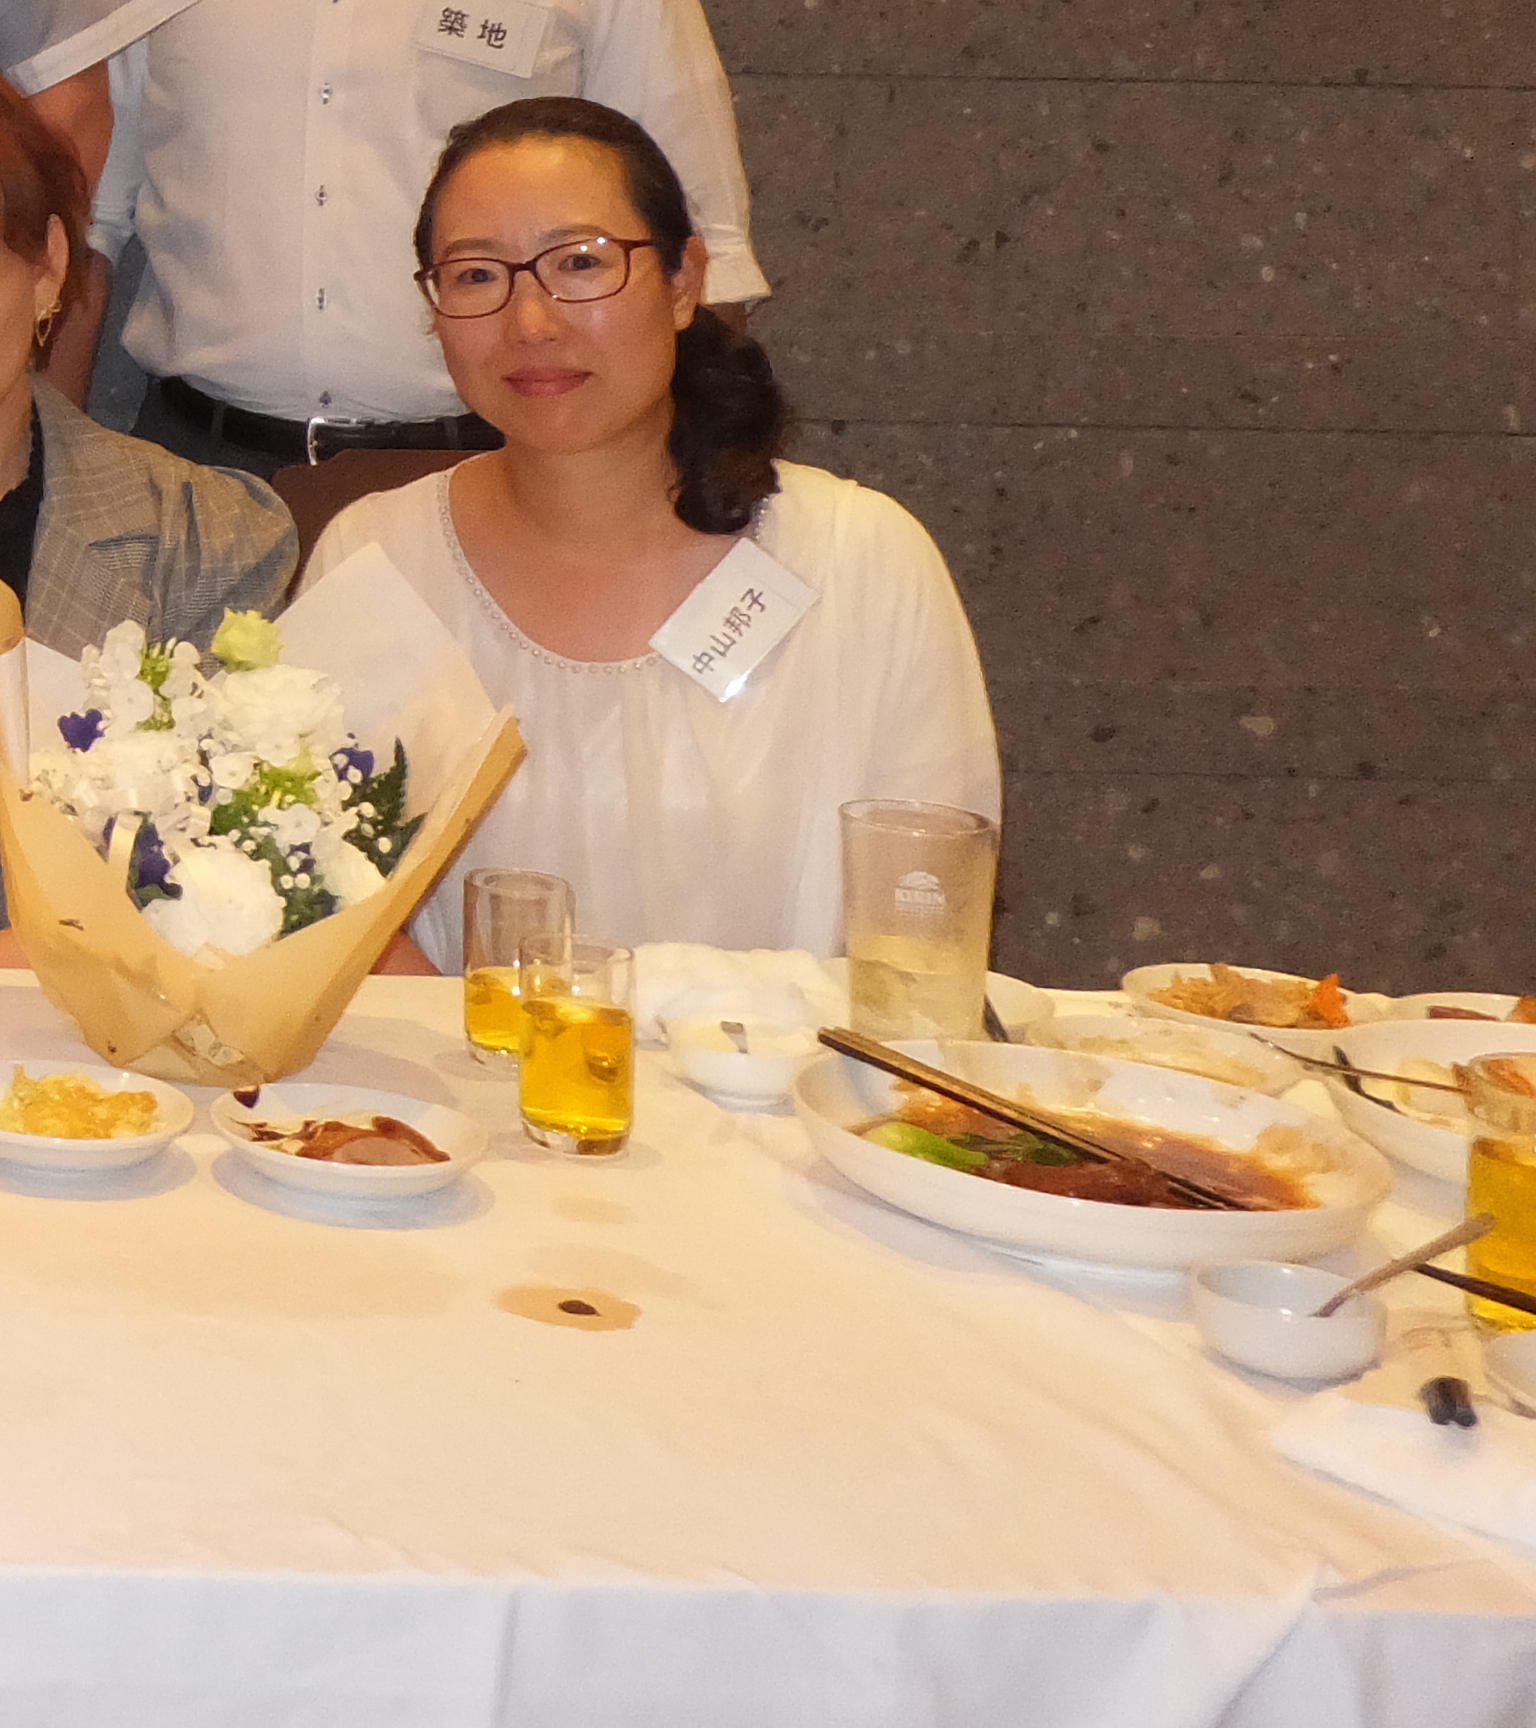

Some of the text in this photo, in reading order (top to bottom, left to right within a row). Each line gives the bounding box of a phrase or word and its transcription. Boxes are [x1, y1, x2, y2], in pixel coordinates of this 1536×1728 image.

[438, 7, 508, 49] 築地
[692, 587, 766, 674] 中山邦子
